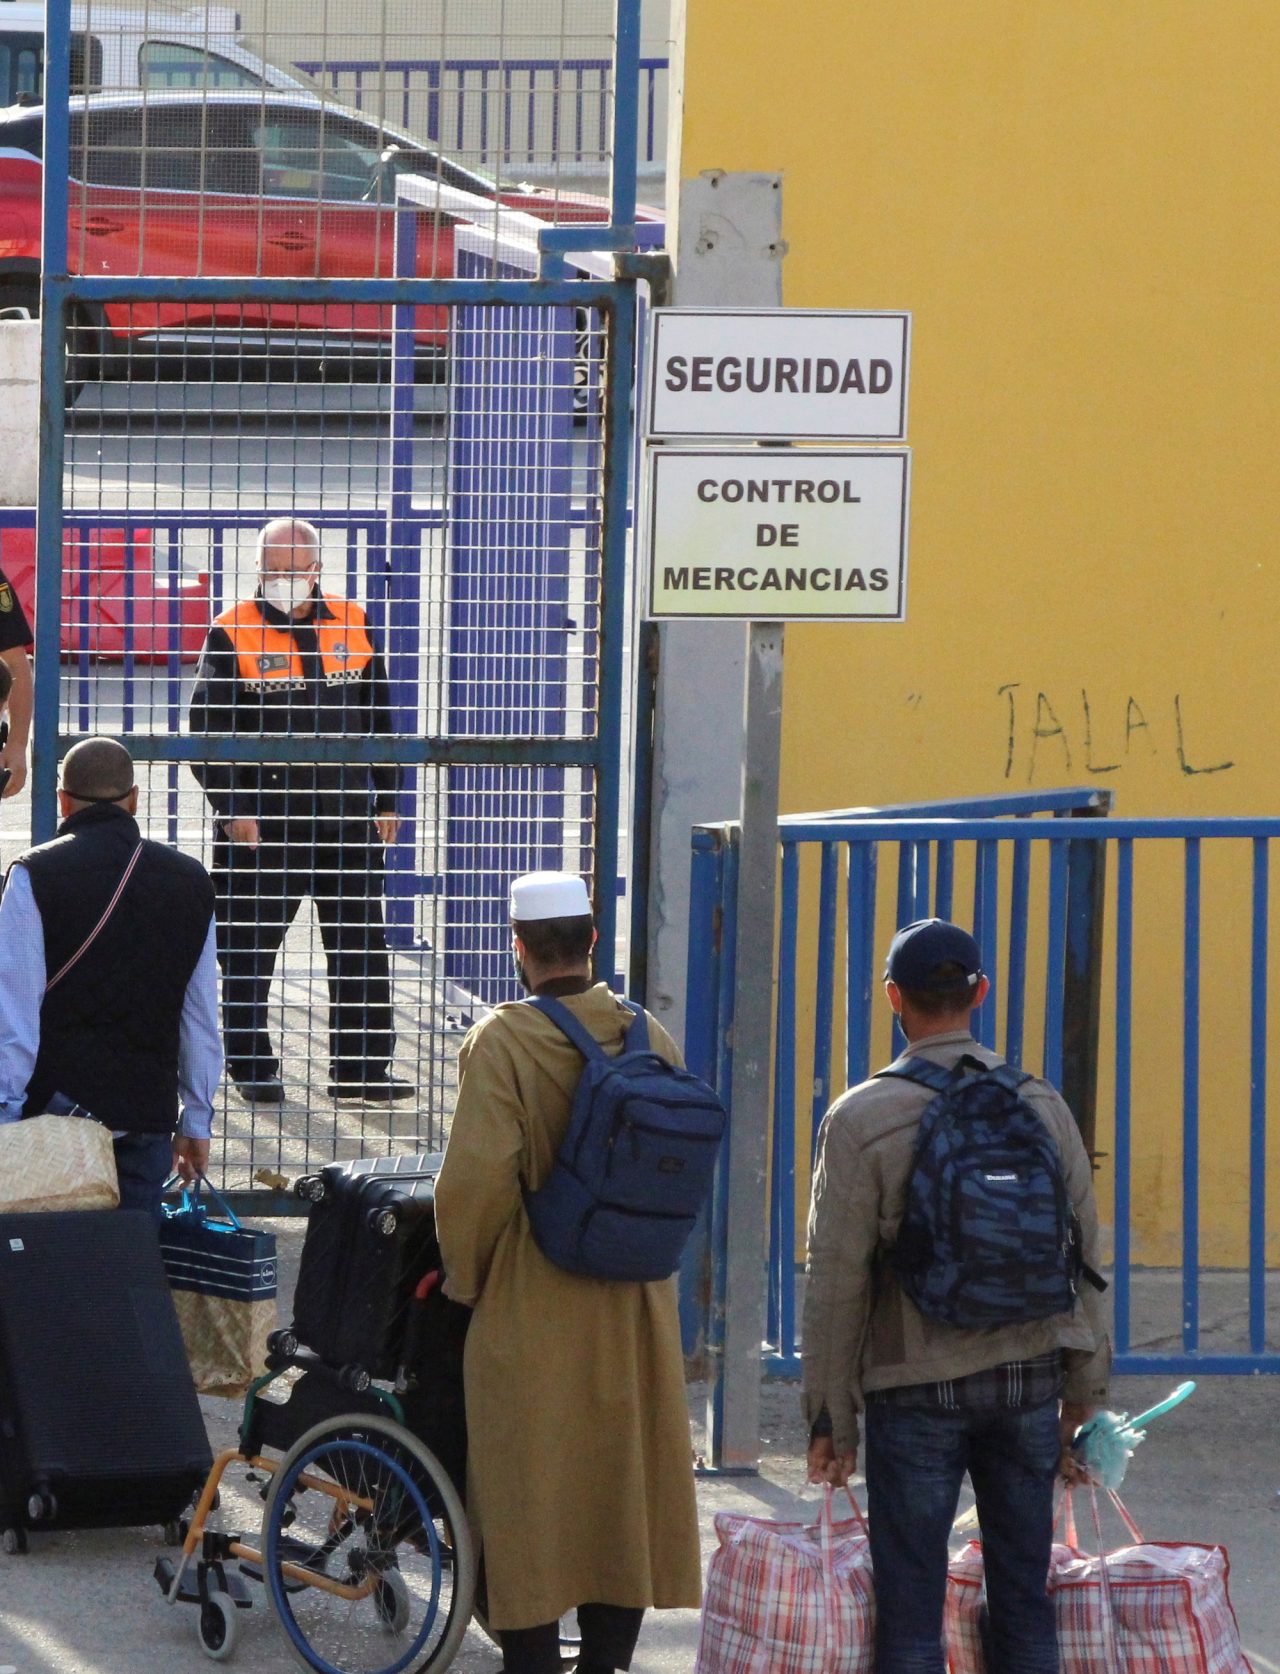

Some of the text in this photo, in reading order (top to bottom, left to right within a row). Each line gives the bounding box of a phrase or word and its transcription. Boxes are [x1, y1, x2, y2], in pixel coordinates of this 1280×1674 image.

[665, 356, 893, 394] SEGURIDAD
[697, 479, 861, 503] CONTROL
[756, 524, 799, 547] DE
[663, 567, 889, 591] MERCANCIAS
[998, 683, 1234, 783] TALAL
